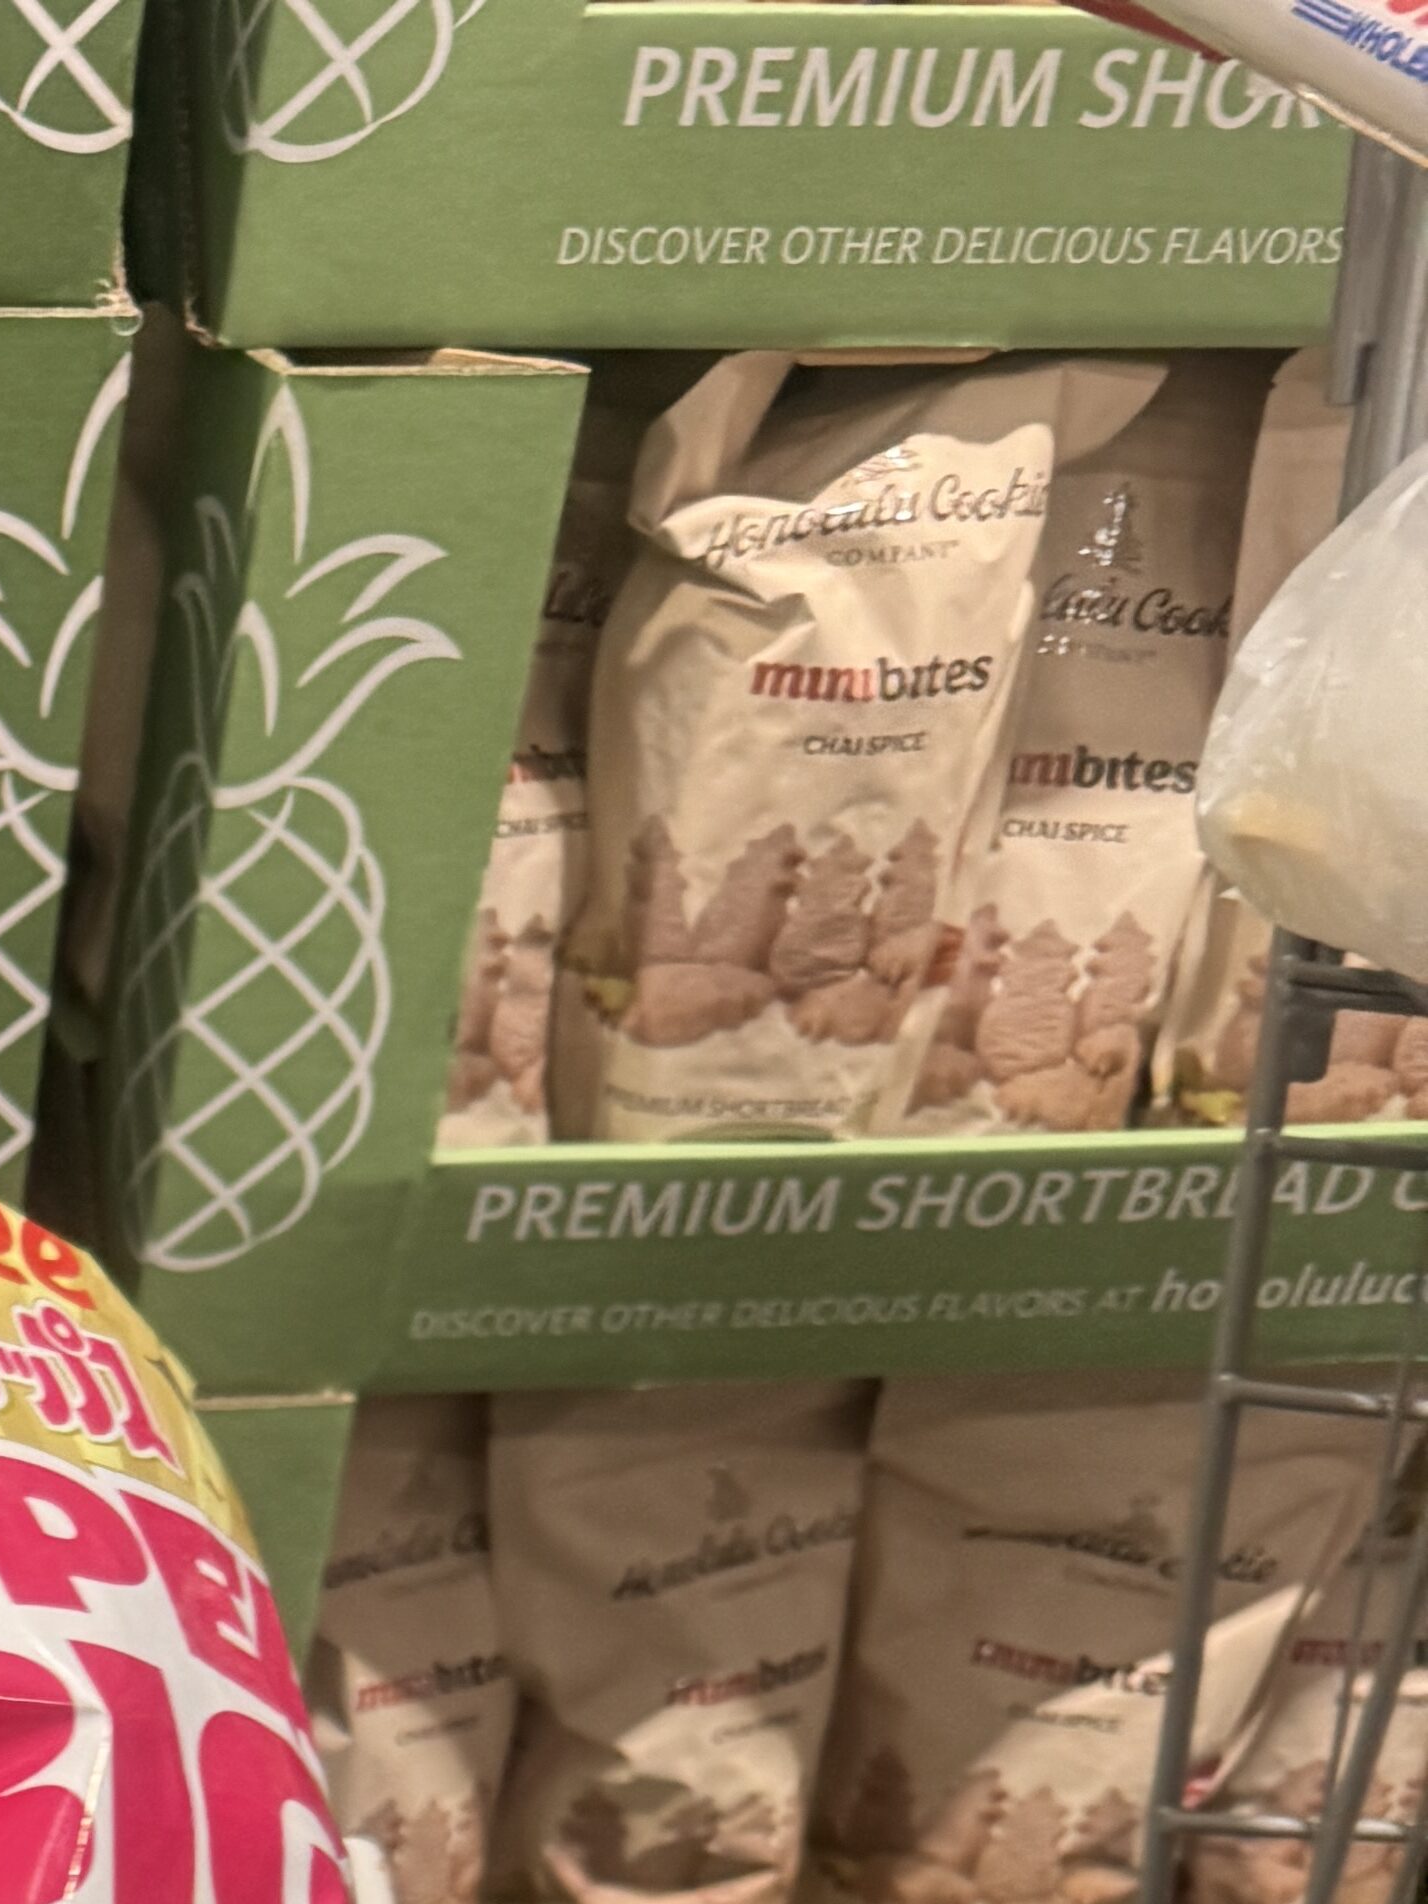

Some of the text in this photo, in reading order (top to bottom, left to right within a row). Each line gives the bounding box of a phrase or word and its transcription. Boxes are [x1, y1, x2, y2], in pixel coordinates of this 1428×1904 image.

[622, 46, 1063, 129] PREMIUM
[556, 226, 1345, 266] DISCOVER OTHER DELICIOUS FLAVORS
[749, 654, 994, 702] minibites
[467, 1177, 840, 1243] PREMIUM
[1150, 1261, 1428, 1315] hooluluc
